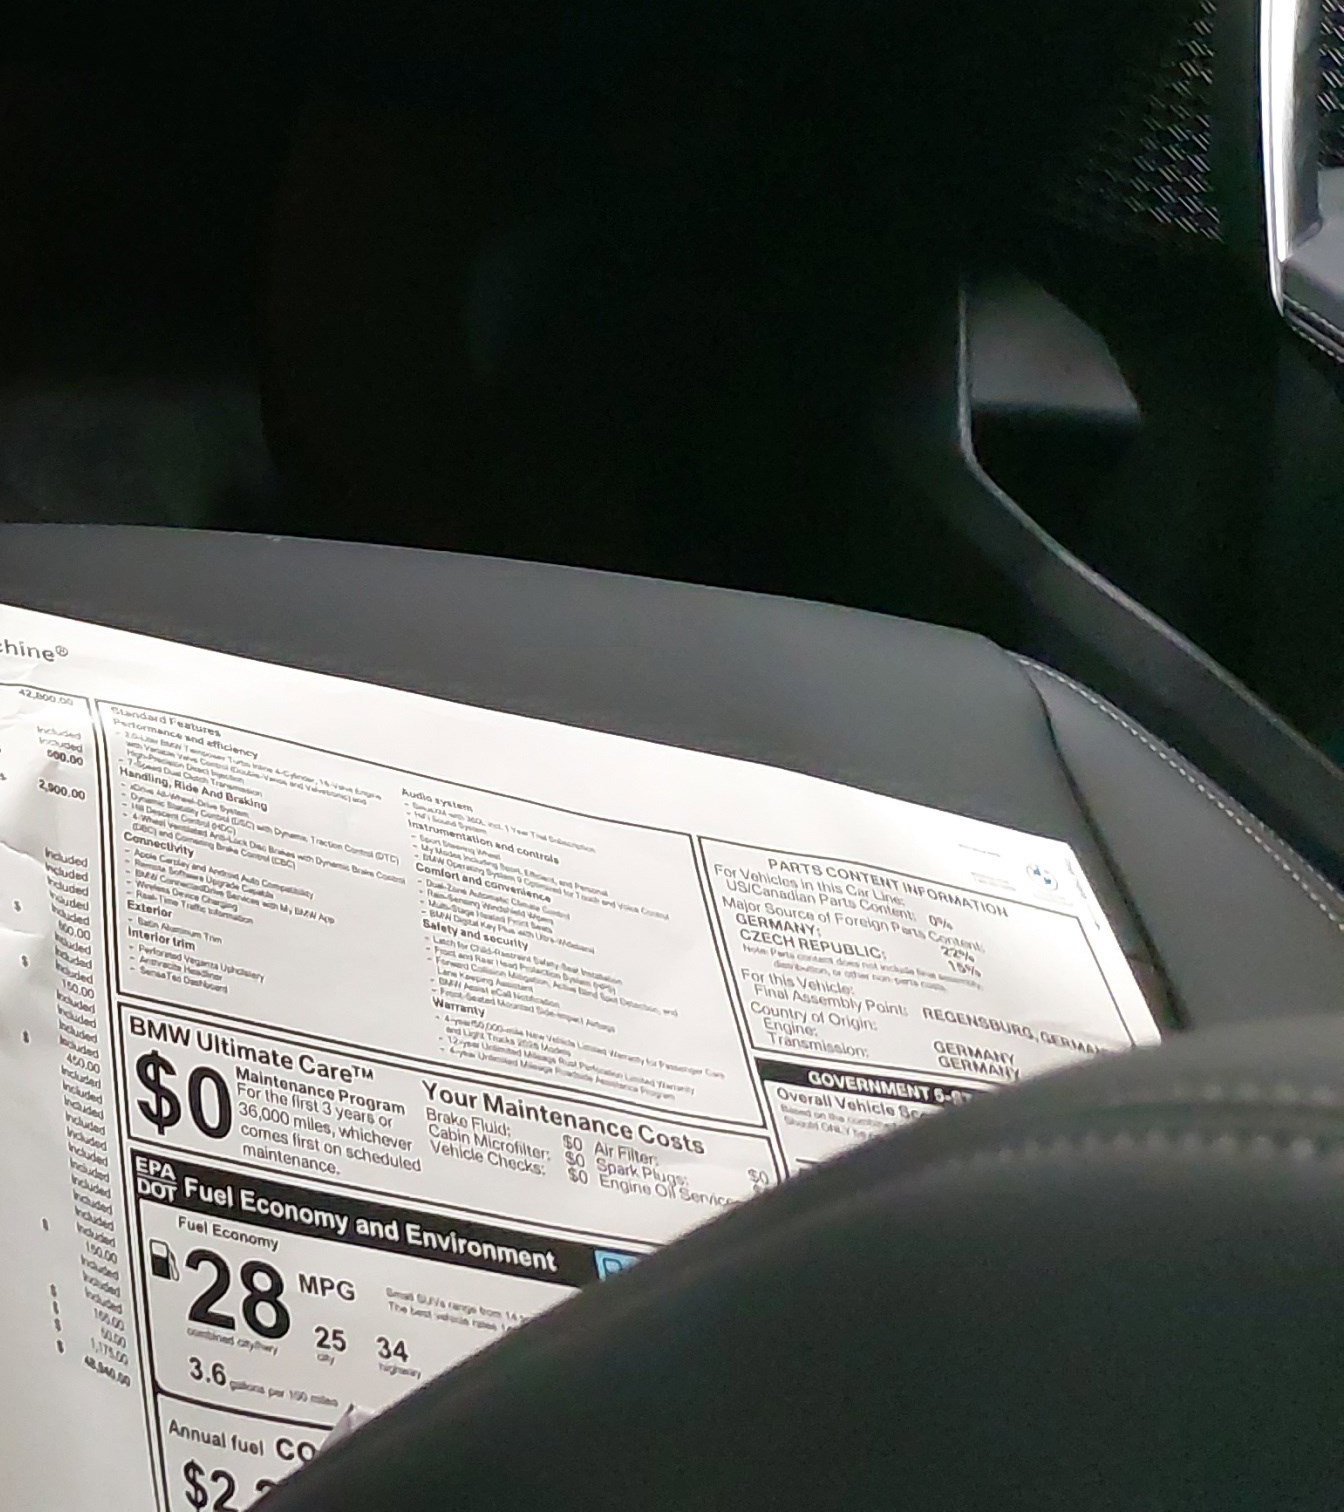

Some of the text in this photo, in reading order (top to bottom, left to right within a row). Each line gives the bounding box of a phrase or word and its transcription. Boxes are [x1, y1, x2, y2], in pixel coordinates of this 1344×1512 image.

[174, 780, 199, 793] Ride
[201, 786, 224, 800] And
[225, 792, 268, 812] Braking
[123, 832, 194, 858] Connectivity
[408, 819, 560, 865] Instrumentation and controls
[416, 863, 460, 883] Comfort
[462, 873, 482, 886] and
[714, 864, 868, 898] For Vehicles in this Car
[768, 858, 822, 876] PARTS
[826, 866, 899, 891] CONTENT
[902, 881, 1009, 918] INFORMATION
[127, 900, 172, 919] Exterior
[722, 896, 889, 932] Major Source of Foreign
[818, 894, 856, 909] Parts
[127, 927, 195, 951] Interior trim
[423, 919, 458, 937] Safety
[460, 928, 481, 940] and
[740, 929, 794, 948] CZECH
[798, 939, 887, 960] REPUBLIC:
[741, 968, 764, 982] For
[768, 973, 795, 987] this
[432, 996, 485, 1018] Warranty
[751, 1001, 807, 1022] Country
[811, 1013, 826, 1023] of
[754, 984, 789, 1000] Final
[793, 991, 862, 1012] Assembly
[129, 1016, 190, 1047] BMW
[197, 1030, 293, 1070] Ultimate
[764, 1018, 1015, 1064] Engine: GERMANY
[938, 1055, 1021, 1080] GERMANY
[136, 1049, 233, 1140] $0
[236, 1066, 406, 1115] Maintenance Program
[236, 1082, 263, 1100] For
[264, 1089, 289, 1104] the
[291, 1093, 320, 1112] first
[777, 1088, 832, 1107] Overall
[836, 1096, 894, 1115] Vehicle
[808, 1071, 931, 1102] GOVERNMENT
[238, 1101, 290, 1126] 36,000
[293, 1115, 336, 1138] miles,
[422, 1080, 705, 1154] Your Maintenance Costs
[426, 1107, 467, 1129] Brake
[562, 1134, 582, 1152] $0
[594, 1142, 614, 1158] Air
[241, 1125, 422, 1173] comes first on scheduled
[243, 1143, 341, 1176] maintenance.
[429, 1124, 470, 1143] Cabin
[474, 1134, 551, 1162] Microfilter:
[565, 1151, 585, 1168] $0
[597, 1158, 638, 1177] Spark
[135, 1155, 177, 1180] EPA
[430, 1140, 676, 1199] Vehicle Checks: $0 Engine Oil
[137, 1177, 177, 1203] DOT
[178, 1217, 279, 1252] Fuel Economy
[185, 1176, 558, 1272] Fuel Economy and Environment
[185, 1249, 356, 1339] 28 MPG
[314, 1326, 409, 1363] 25 34
[189, 1356, 227, 1387] 3.6
[169, 1419, 264, 1456] Annual fuel
